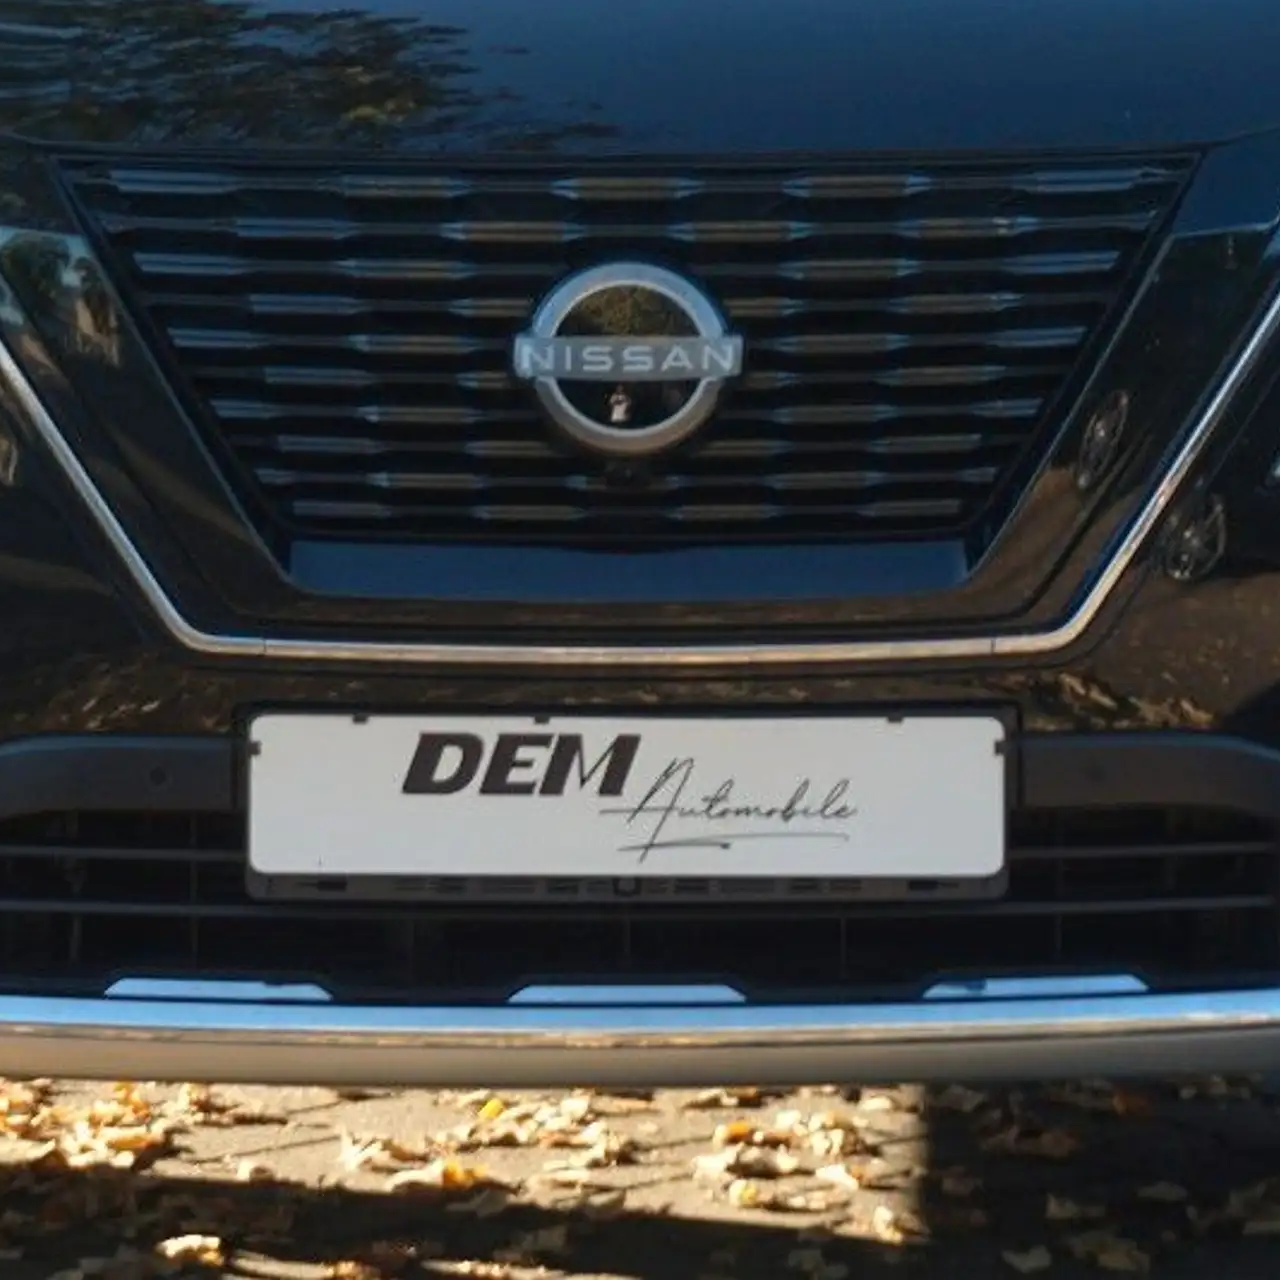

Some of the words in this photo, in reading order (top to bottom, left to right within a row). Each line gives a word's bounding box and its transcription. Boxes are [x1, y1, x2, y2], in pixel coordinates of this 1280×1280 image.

[521, 344, 734, 372] NISSAN
[401, 732, 642, 796] DEM
[598, 756, 858, 863] Automobile
